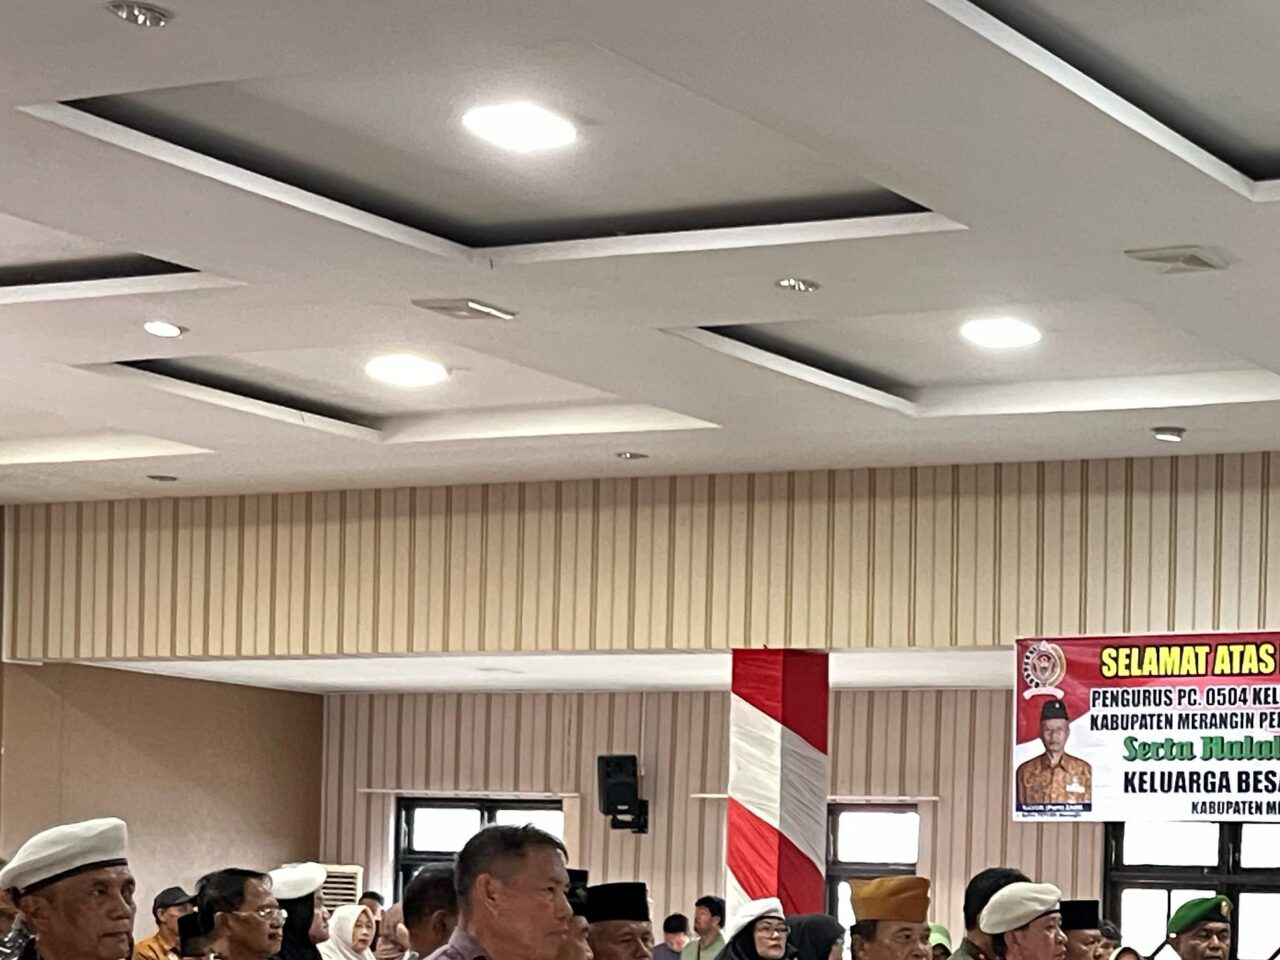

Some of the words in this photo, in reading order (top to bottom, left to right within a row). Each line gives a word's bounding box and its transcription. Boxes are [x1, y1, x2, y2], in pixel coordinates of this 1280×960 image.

[1101, 645, 1210, 678] SELAMAT
[1213, 643, 1276, 675] ATAS
[1092, 688, 1173, 708] PENGURUS
[1177, 688, 1202, 707] PC.
[1206, 687, 1248, 706] 0504
[1090, 713, 1173, 731] KABUPATEN
[1177, 712, 1254, 730] MERANGIN
[1122, 735, 1197, 761] Serta
[1123, 770, 1232, 794] KELUARGA
[1191, 801, 1263, 815] KABUPATEN
